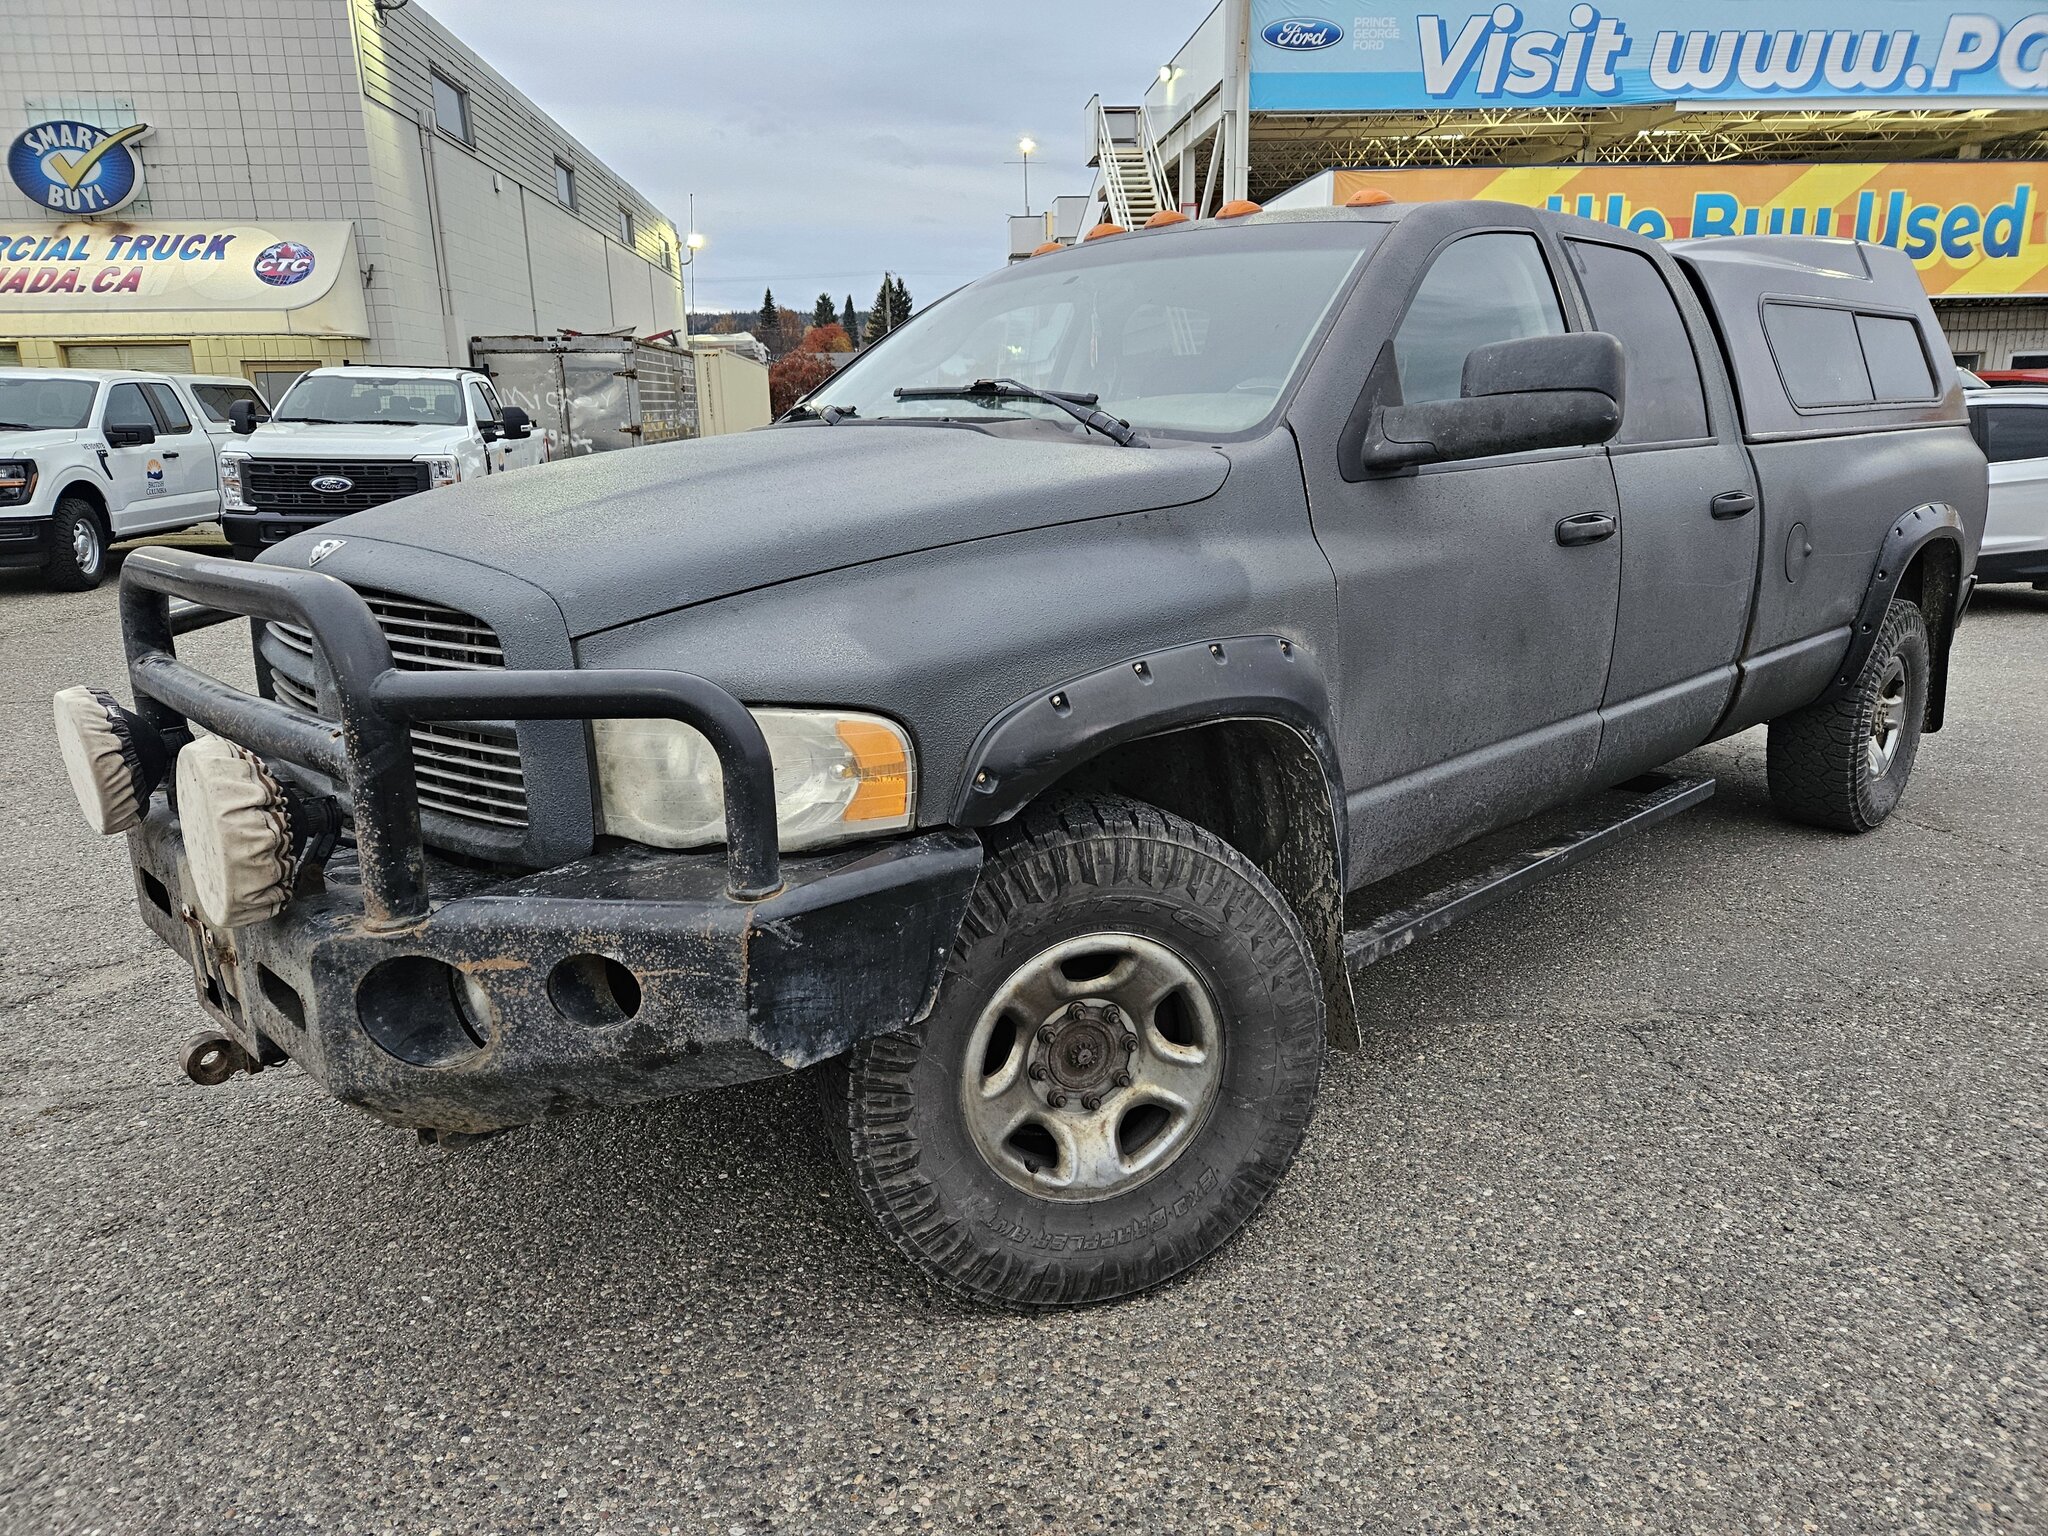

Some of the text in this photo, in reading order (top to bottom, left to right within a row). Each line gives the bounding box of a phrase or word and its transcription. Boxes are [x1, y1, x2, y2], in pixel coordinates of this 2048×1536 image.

[1277, 21, 1328, 45] Ford
[1353, 28, 1400, 39] GEORGE
[1354, 17, 1397, 28] PRINCE
[1353, 40, 1384, 50] FORD
[1416, 3, 1629, 96] Visit
[24, 124, 108, 157] SMART
[48, 184, 109, 210] BUY!
[1855, 183, 2032, 260] Used
[105, 234, 237, 260] TRUCK
[256, 258, 311, 272] CTC
[320, 479, 343, 489] Ford
